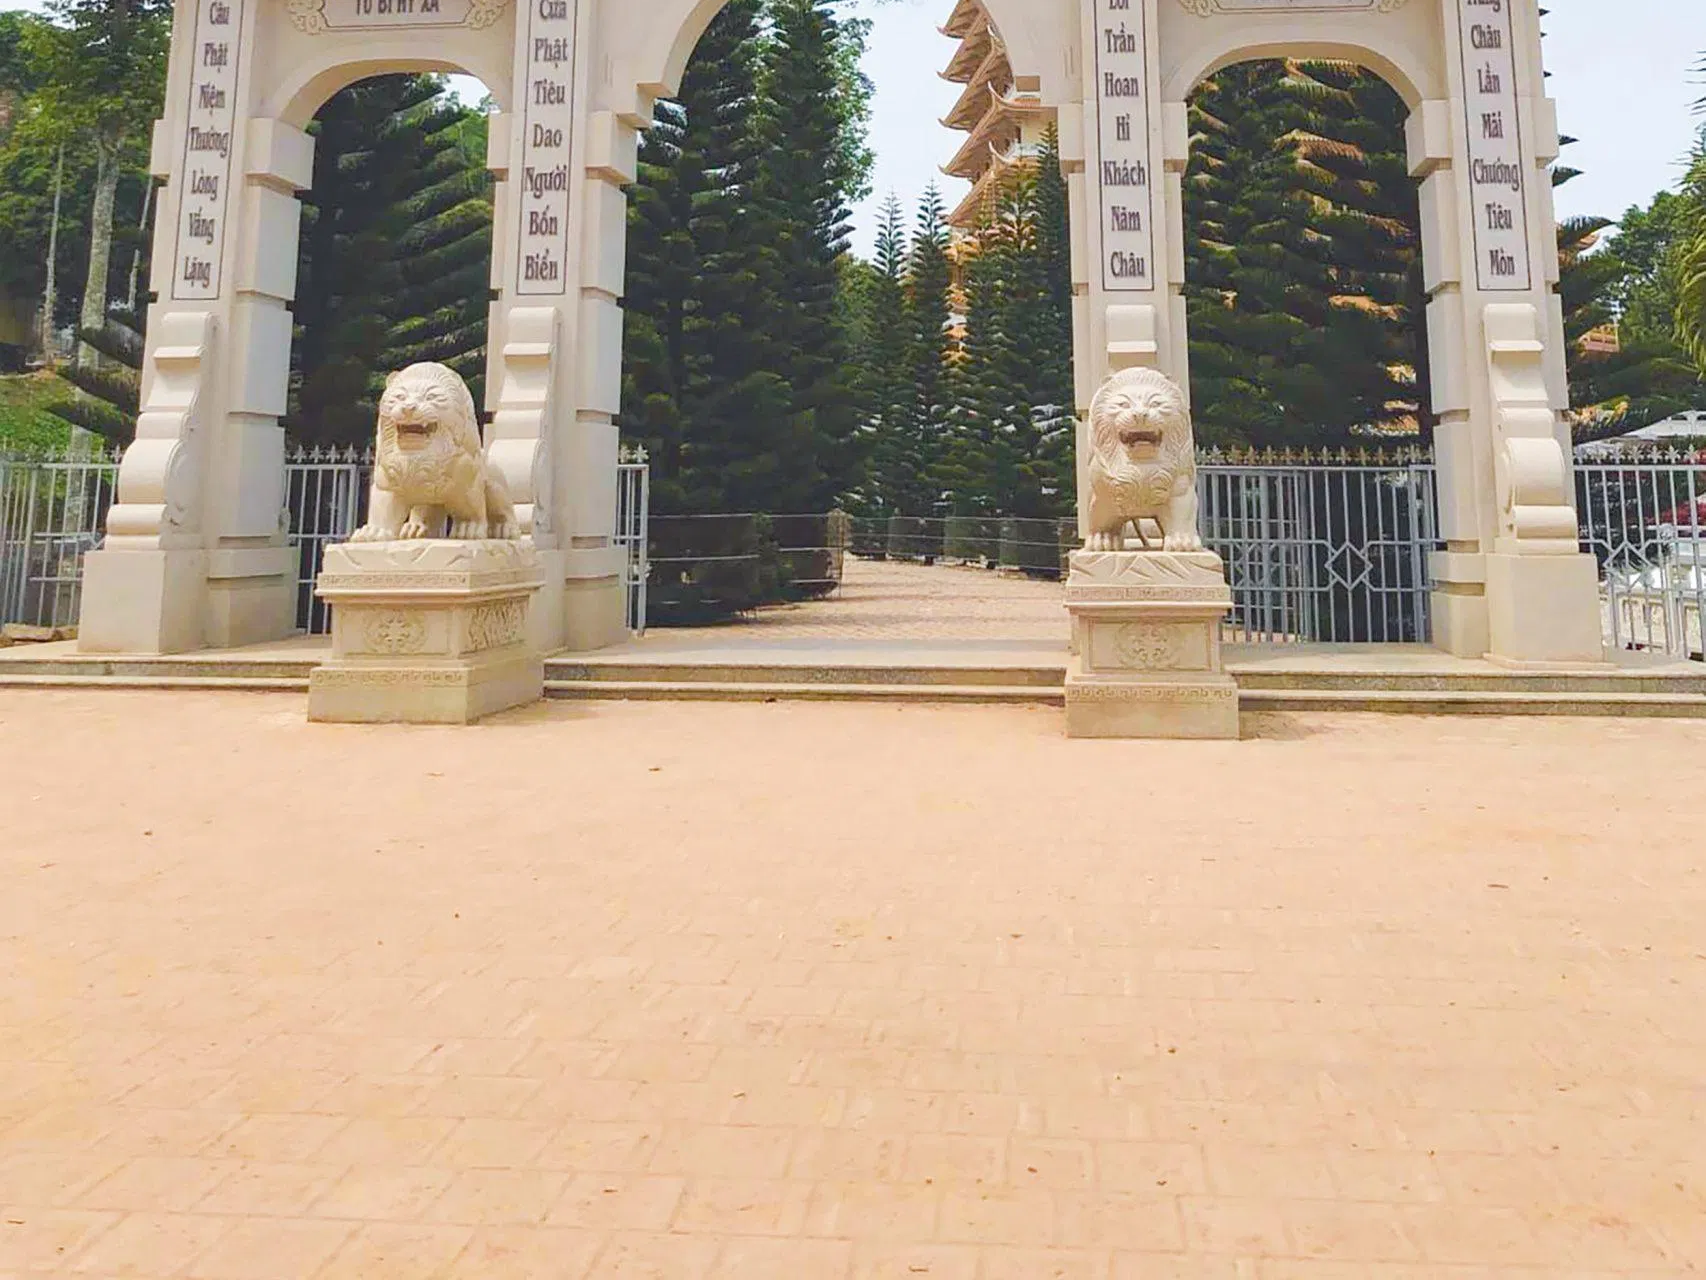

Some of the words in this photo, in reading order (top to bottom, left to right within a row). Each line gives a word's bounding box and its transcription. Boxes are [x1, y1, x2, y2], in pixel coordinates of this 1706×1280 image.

[1104, 21, 1136, 53] Trần
[534, 37, 568, 69] Phật
[533, 78, 566, 105] Tiêu
[1104, 72, 1139, 97] Hoan
[533, 123, 562, 148] Dao
[524, 165, 567, 199] Người
[1103, 159, 1146, 187] Khách
[529, 205, 558, 236] Bốn
[524, 248, 558, 281] Biển
[1110, 251, 1145, 279] Châu
